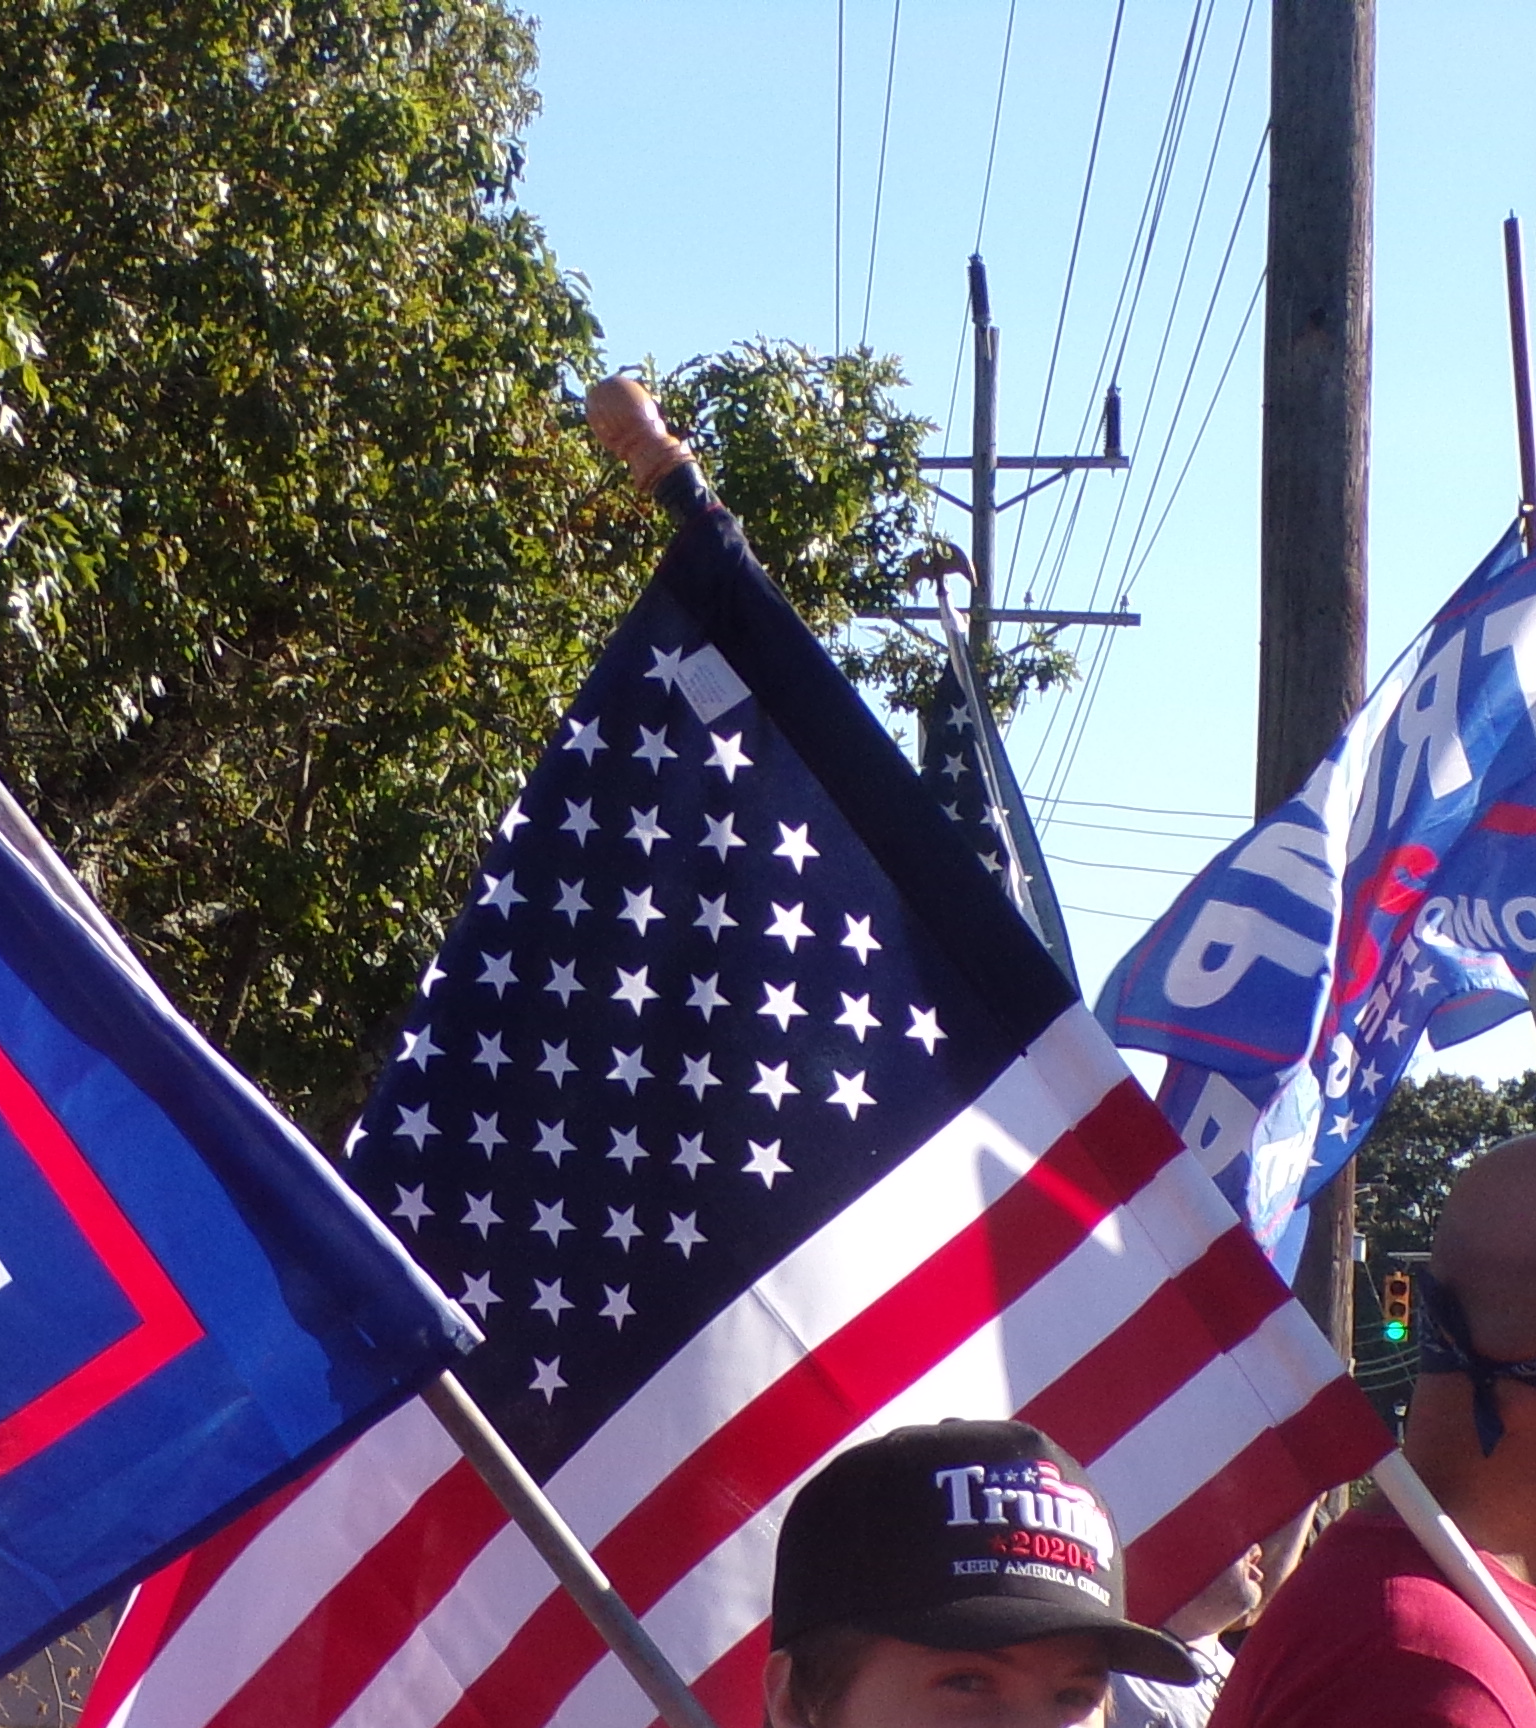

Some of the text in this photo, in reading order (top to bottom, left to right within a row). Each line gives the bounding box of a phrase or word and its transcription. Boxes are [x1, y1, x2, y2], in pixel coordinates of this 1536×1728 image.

[1011, 1530, 1081, 1568] 2020
[952, 1558, 1111, 1608] KEEP AMERICA GREAT
